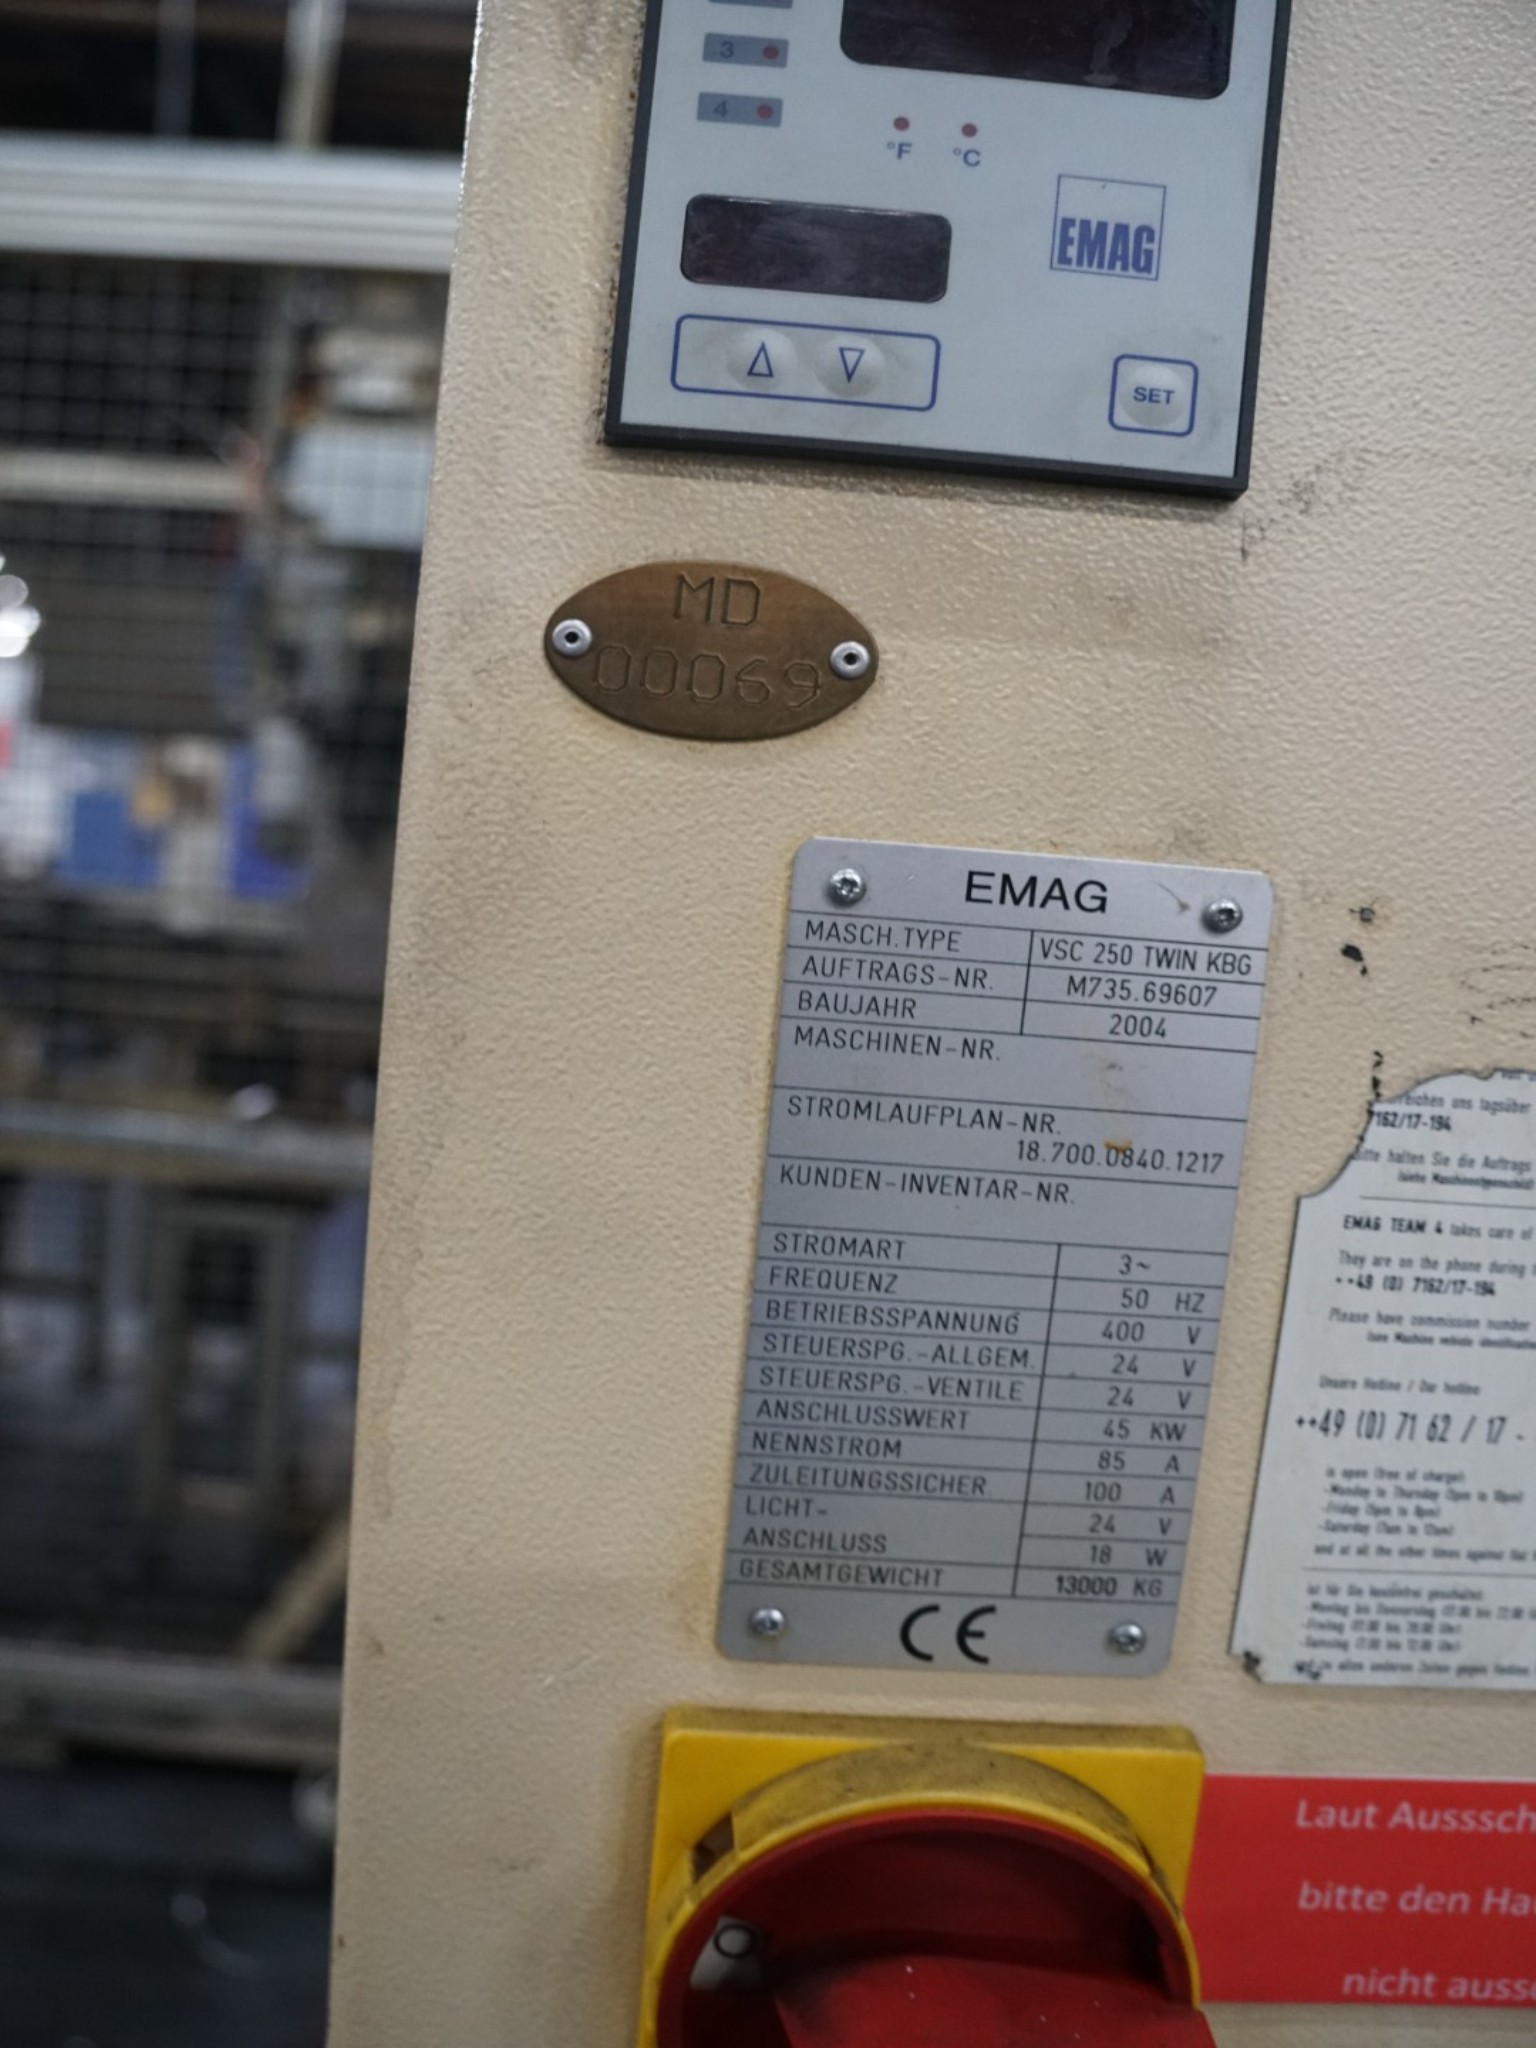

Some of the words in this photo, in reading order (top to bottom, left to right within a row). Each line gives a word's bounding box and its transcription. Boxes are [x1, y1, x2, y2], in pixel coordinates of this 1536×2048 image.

[720, 41, 734, 59] 3
[713, 100, 728, 118] 4
[1057, 217, 1155, 274] EMAG
[1133, 386, 1175, 405] SET
[673, 572, 761, 626] MD
[593, 645, 821, 708] 00069
[964, 870, 1108, 914] EMAG
[805, 920, 961, 952] MASCH.TYPE
[1040, 937, 1083, 962] VSC
[1093, 942, 1132, 966] 250
[1144, 946, 1197, 971] TWIN
[1206, 950, 1253, 976] KBG
[801, 955, 994, 991] AUFTRAGS-NR.
[798, 990, 917, 1019] BAUJAHR
[1067, 975, 1218, 1008] M735.69607
[1108, 1014, 1168, 1038] 2004
[794, 1025, 1000, 1061] MASCHINEN-NR.
[787, 1096, 1061, 1135] STROMLAUFPLAN-NR.
[1016, 1140, 1225, 1175] 18.700.0840.1217
[1387, 1150, 1424, 1165] halten
[1432, 1152, 1450, 1166] Sie
[1458, 1154, 1475, 1168] die
[780, 1163, 1075, 1204] KUNDEN-INVENTAR-NR.
[1343, 1214, 1381, 1231] EMAG
[1391, 1217, 1426, 1233] TEAM
[1434, 1221, 1443, 1235] 4
[1450, 1223, 1481, 1238] takes
[1488, 1227, 1513, 1240] care
[1521, 1226, 1533, 1240] of
[773, 1232, 905, 1260] STROMART
[1339, 1250, 1366, 1269] They
[1372, 1254, 1391, 1267] are
[1400, 1257, 1413, 1268] on
[1420, 1256, 1438, 1270] the
[1446, 1259, 1482, 1273] phone
[769, 1265, 899, 1294] FREQUENZ
[1383, 1275, 1403, 1292] (0)
[1121, 1289, 1149, 1309] 50
[1174, 1292, 1206, 1314] HZ
[766, 1299, 1020, 1336] BETRIEBSSPANNUNG
[1328, 1307, 1369, 1324] Please
[1376, 1310, 1404, 1326] have
[1101, 1320, 1145, 1342] 400
[1187, 1325, 1201, 1345] V
[1111, 1354, 1139, 1375] 24
[1182, 1358, 1196, 1377] V
[1106, 1386, 1134, 1407] 24
[1177, 1391, 1191, 1410] V
[756, 1399, 971, 1430] ANSCHLUSSWERT
[1356, 1410, 1385, 1440] (0)
[1395, 1411, 1417, 1441] 71
[1426, 1413, 1452, 1443] 62
[1460, 1415, 1477, 1443] /
[1486, 1416, 1507, 1444] 17
[1102, 1418, 1130, 1439] 45
[1150, 1422, 1186, 1442] KW
[752, 1430, 902, 1459] NENNSTROM
[1097, 1451, 1126, 1471] 85
[1165, 1455, 1180, 1474] A
[750, 1463, 987, 1497] ZULEITUNGSSICHER
[1084, 1481, 1122, 1502] 100
[1160, 1486, 1176, 1505] A
[746, 1497, 828, 1519] LICHT-
[1088, 1514, 1116, 1534] 24
[1159, 1517, 1173, 1537] V
[743, 1528, 887, 1554] ANSCHLUSS
[1090, 1544, 1112, 1565] 18
[1145, 1548, 1168, 1568] W
[739, 1561, 944, 1589] GESAMTGEWICHT
[1056, 1575, 1118, 1597] 13000
[1133, 1577, 1163, 1598] KG
[900, 1604, 997, 1665] CE
[1296, 1799, 1380, 1829] Laut
[1298, 1881, 1389, 1912] bitte
[1398, 1883, 1471, 1914] den
[1482, 1887, 1536, 1917] Ha
[1342, 1968, 1437, 1999] nicht
